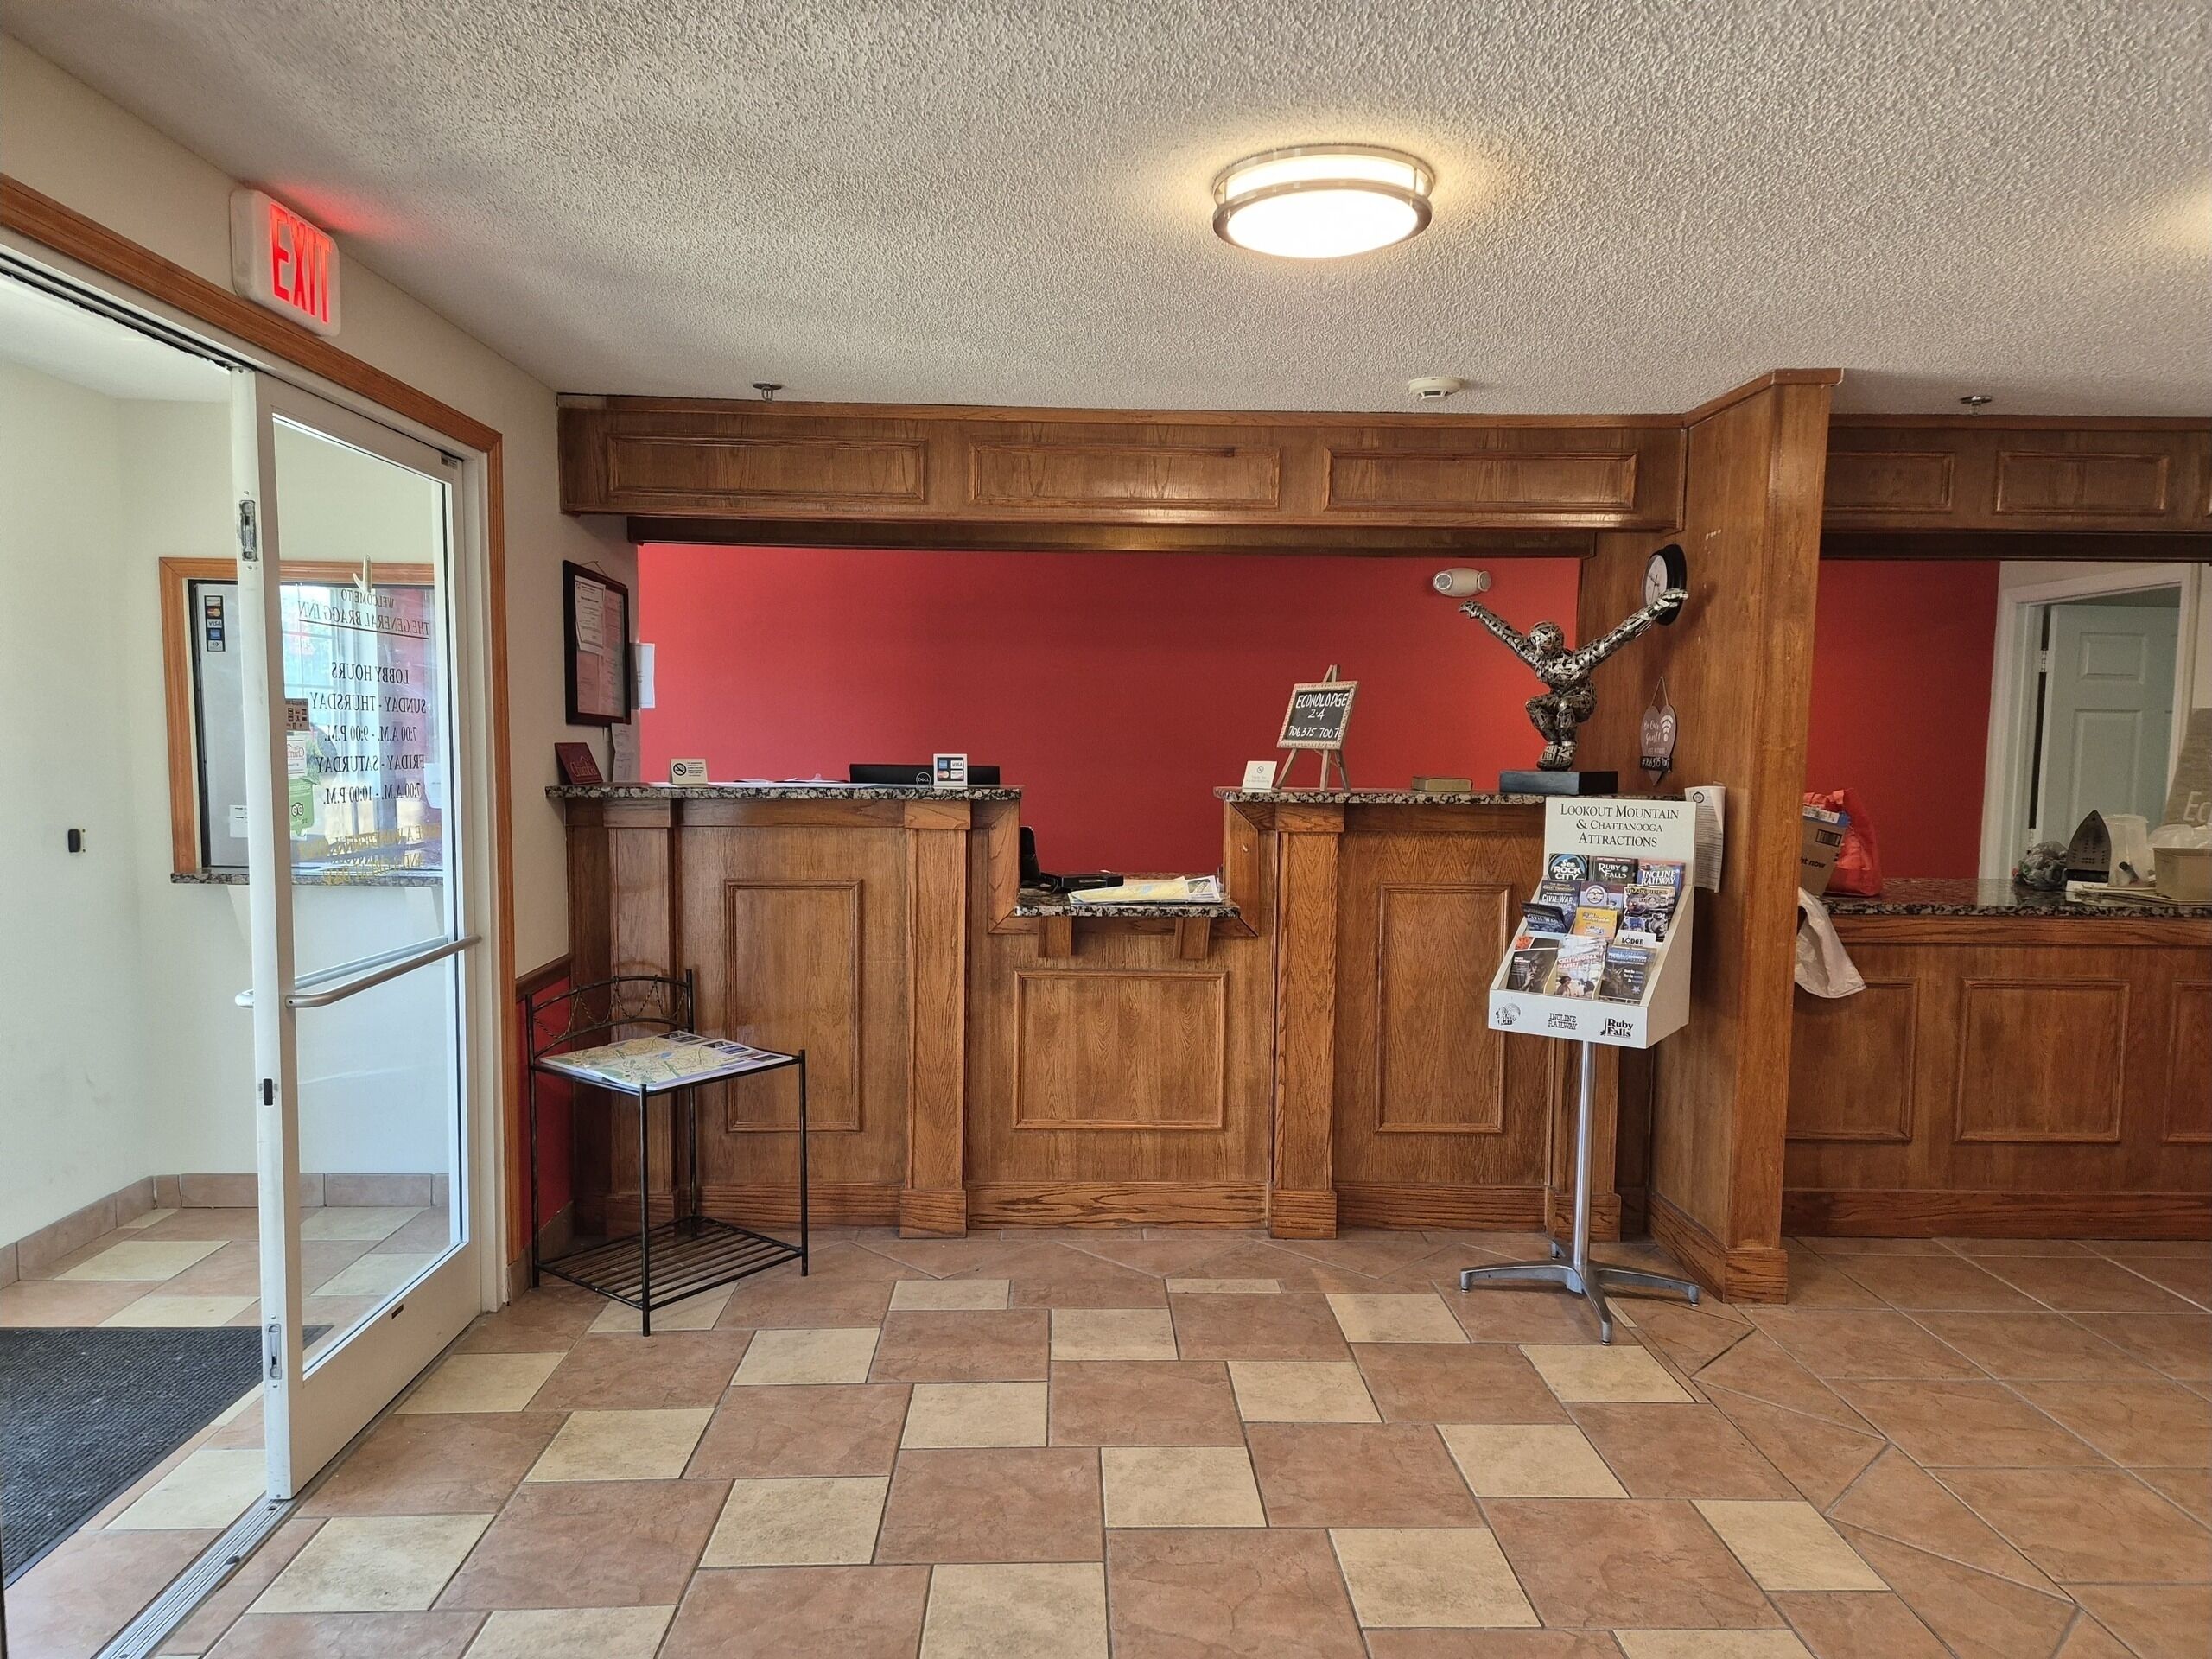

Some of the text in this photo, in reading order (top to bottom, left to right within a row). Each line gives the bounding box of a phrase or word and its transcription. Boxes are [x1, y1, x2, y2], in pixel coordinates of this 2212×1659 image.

[270, 202, 332, 324] EXIT
[1296, 693, 1349, 708] ECONOLODGE
[1560, 803, 1679, 820] LOOKOUT MOUNTAIN
[1576, 819, 1663, 833] & CHATTANOOGA
[1579, 832, 1657, 848] ATTRACTIONS
[1560, 859, 1575, 868] See
[1598, 863, 1621, 873] RUBY
[1554, 866, 1581, 874] ROCK
[1605, 870, 1627, 879] FALLS
[1642, 869, 1676, 878] INCLINE
[1642, 877, 1675, 886] RAILWAY
[1541, 893, 1558, 903] CIVIL
[1622, 936, 1643, 945] LODGE
[1549, 1013, 1576, 1023] INCLINE
[1548, 1020, 1577, 1030] RAILWAY
[1607, 1018, 1633, 1030] Ruby
[1607, 1027, 1631, 1037] Falls
